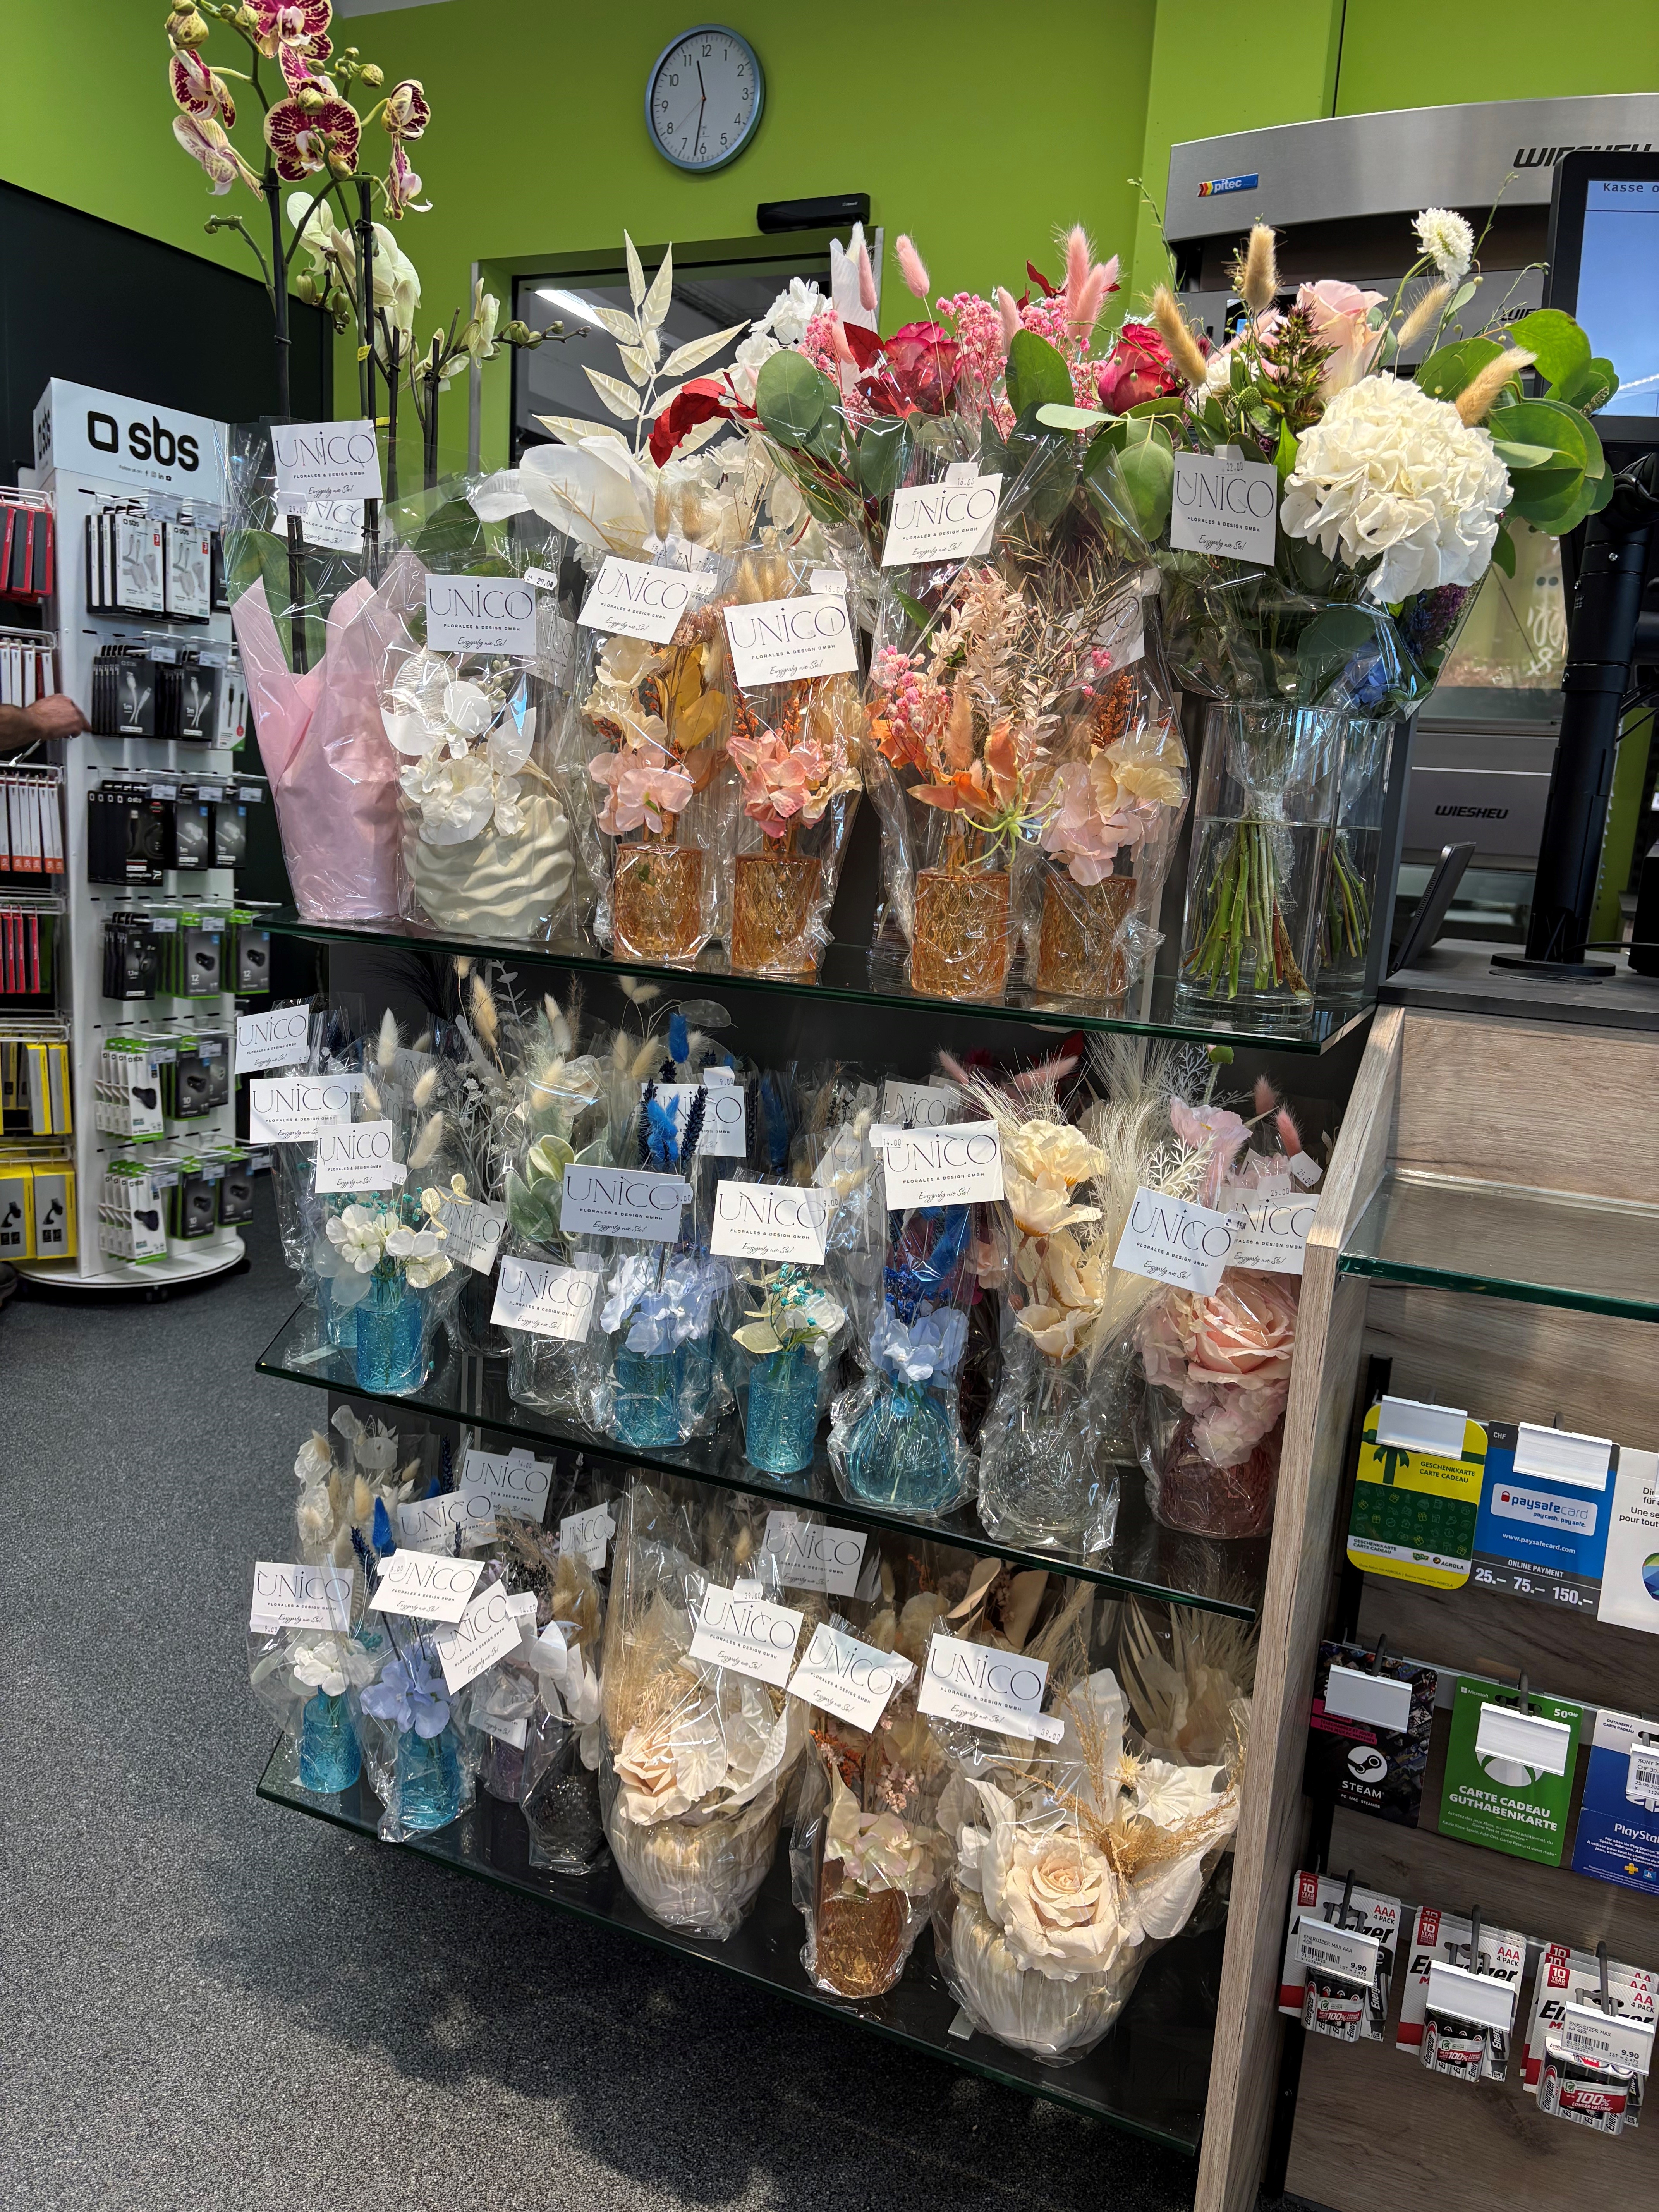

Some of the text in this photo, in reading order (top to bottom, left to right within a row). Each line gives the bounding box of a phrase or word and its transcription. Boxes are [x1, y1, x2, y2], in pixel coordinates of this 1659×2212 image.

[701, 44, 712, 57] 12
[723, 49, 728, 61] 1
[683, 54, 692, 67] 11
[737, 64, 744, 77] 2
[669, 74, 679, 87] 10
[742, 88, 749, 100] 3
[661, 101, 668, 112] 9
[734, 113, 741, 125] 4
[666, 122, 673, 134] 8
[681, 138, 687, 149] 7
[720, 133, 727, 146] 5
[699, 142, 706, 155] 6
[1214, 179, 1242, 193] pitec
[1603, 182, 1644, 192] Kasse
[128, 416, 199, 472] sbs
[1226, 462, 1243, 472] 22.00
[536, 577, 553, 588] 29.00
[752, 651, 785, 660] FLORALES
[1435, 805, 1510, 819] WIESHEU
[394, 1175, 405, 1183] 9.00
[1297, 1169, 1314, 1185] 25.00
[1271, 1188, 1290, 1197] 25.00
[823, 1199, 838, 1207] 9.00
[1493, 1432, 1506, 1440] CHF
[1420, 1461, 1475, 1477] GESCHENKKARTE
[1420, 1469, 1468, 1483] CARTE CADEAU
[1643, 1496, 1656, 1504] für
[1511, 1494, 1588, 1520] paysafecard
[1630, 1506, 1648, 1517] Une
[1533, 1511, 1544, 1520] pay
[1561, 1517, 1572, 1525] pay
[1619, 1515, 1640, 1525] pour
[1353, 1539, 1397, 1551] GESCHENKKARTE
[1503, 1532, 1576, 1554] www.paysafecard.com
[1370, 1546, 1391, 1554] CADEAU
[1441, 1561, 1464, 1570] AGROLA
[1508, 1559, 1564, 1578] ONLINE PAYMENT
[744, 1592, 761, 1600] 39.00
[1468, 1689, 1489, 1698] Microsoft
[1041, 1728, 1060, 1741] 39.00
[1341, 1780, 1382, 1799] STEAM
[1459, 1785, 1551, 1818] CARTE CADEAU
[1449, 1793, 1558, 1832] GUTHABENKARTE
[1302, 1883, 1315, 1892] 10
[1374, 1905, 1396, 1918] AAA
[1379, 1917, 1395, 1925] PACK
[1422, 1922, 1436, 1933] 10
[1304, 1934, 1330, 1946] ENERGIZER
[1497, 1946, 1520, 1961] AAA
[1350, 1962, 1367, 1972] 9.90
[1503, 1957, 1519, 1966] PACK
[1552, 1967, 1566, 1978] 10
[1633, 1992, 1654, 2006] AA
[1637, 2003, 1655, 2013] PACK
[1569, 2021, 1599, 2033] ENERGIZER
[1424, 2035, 1435, 2065] Energizer
[1621, 2049, 1640, 2059] 9.90
[1448, 2052, 1468, 2061] 100%
[1542, 2079, 1554, 2111] Energizer
[1576, 2092, 1611, 2107] 100%
